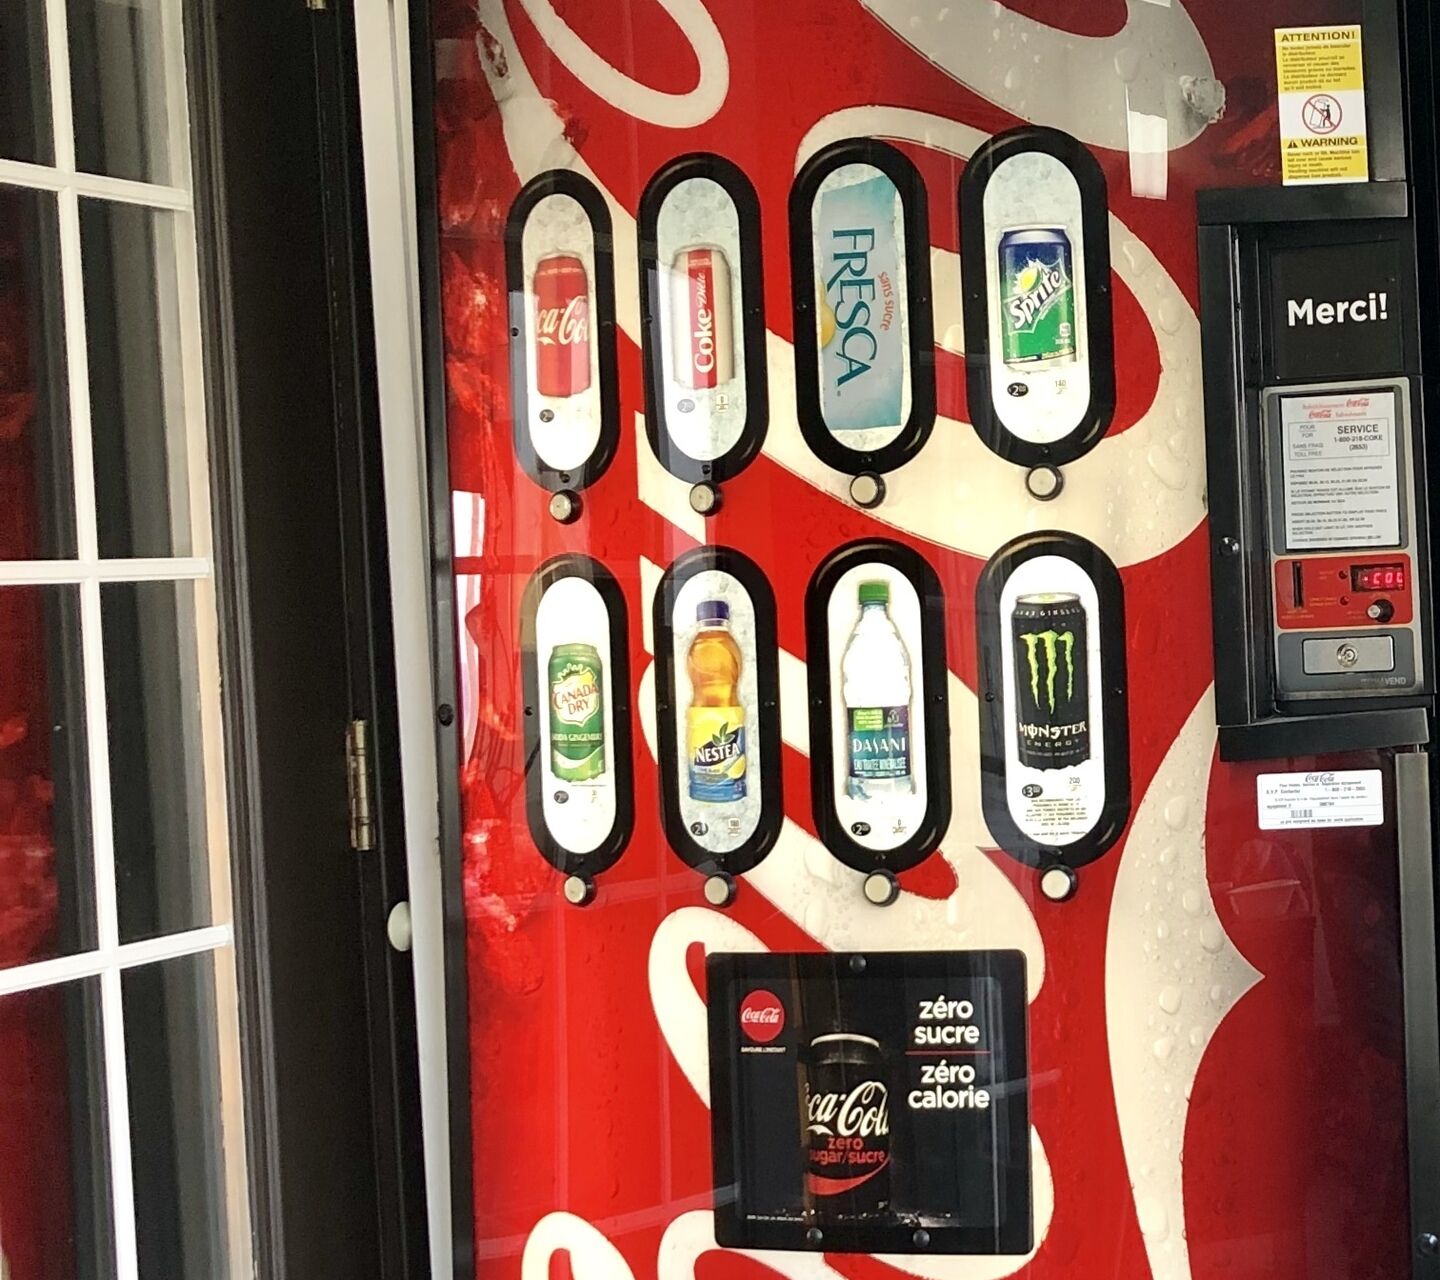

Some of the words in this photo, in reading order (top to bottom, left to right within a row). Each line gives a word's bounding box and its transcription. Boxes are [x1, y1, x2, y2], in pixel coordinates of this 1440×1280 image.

[1281, 31, 1355, 42] ATTENTION!
[1301, 137, 1358, 147] WARNING
[827, 228, 878, 387] FRESCA
[1009, 270, 1063, 329] Sprite
[1287, 293, 1388, 327] Merci!
[694, 308, 715, 374] Coke
[1337, 424, 1379, 435] SERVICE
[552, 683, 599, 709] CANADA
[568, 699, 590, 716] DRY
[696, 742, 740, 763] NESTEA
[852, 737, 906, 755] DASANI
[919, 994, 974, 1020] zéro
[914, 1025, 980, 1045] sucre
[920, 1059, 976, 1084] zéro
[907, 1087, 991, 1110] calorie
[827, 1137, 865, 1150] zero
